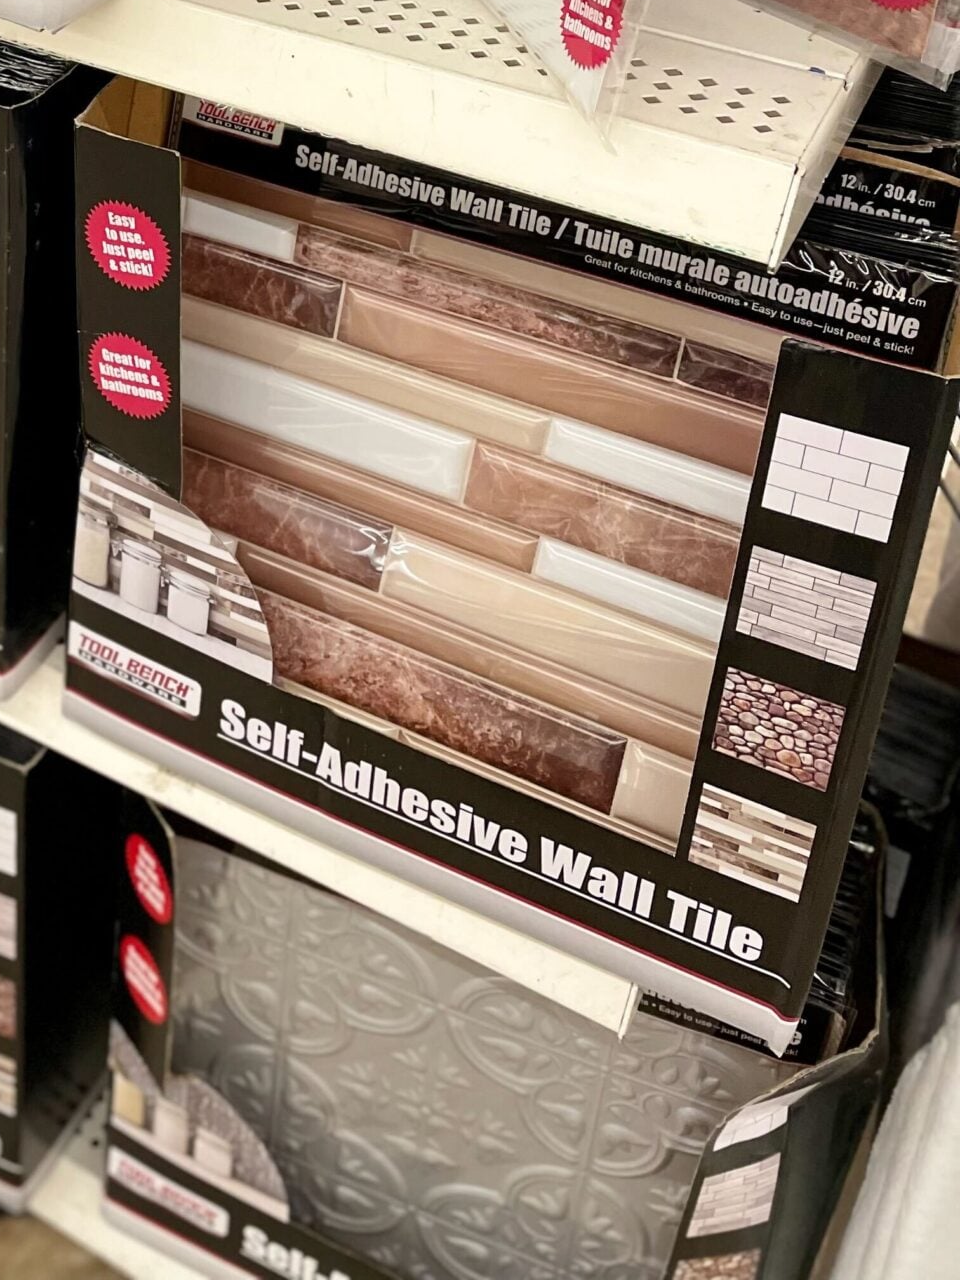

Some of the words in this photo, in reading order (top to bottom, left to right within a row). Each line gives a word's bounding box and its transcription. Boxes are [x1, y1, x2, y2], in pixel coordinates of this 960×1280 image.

[564, 15, 611, 51] bathrooms
[603, 15, 613, 30] &
[198, 114, 269, 138] HARDWARE
[231, 110, 277, 133] BENCH
[841, 173, 857, 190] 12
[858, 182, 871, 194] in.
[873, 183, 884, 195] /
[883, 183, 917, 204] 30.4
[918, 199, 936, 208] cm
[107, 211, 135, 231] Easy
[105, 227, 118, 241] to
[119, 230, 145, 245] use.
[295, 144, 445, 206] Self-Adhesive
[450, 186, 503, 223] Wall
[507, 202, 551, 238] Tile
[554, 218, 570, 240] /
[573, 220, 634, 259] Tuile
[638, 242, 730, 286] murale
[734, 270, 921, 340] autoadhésive
[102, 241, 127, 258] Just
[127, 246, 155, 263] peel
[109, 259, 119, 271] &
[119, 260, 153, 277] stick!
[828, 269, 845, 286] 12
[845, 278, 860, 290] in.
[862, 280, 872, 292] /
[872, 280, 907, 303] 30.4
[907, 297, 927, 308] cm
[584, 254, 612, 270] Great
[613, 262, 628, 274] for
[629, 266, 673, 287] kitchens
[674, 280, 682, 290] &
[685, 282, 741, 307] bathrooms
[751, 302, 778, 319] Easy
[779, 308, 791, 321] to
[846, 330, 871, 345] peel
[873, 337, 881, 348] &
[883, 339, 915, 356] stick!
[101, 348, 133, 367] Great
[134, 354, 151, 370] for
[98, 362, 149, 385] kitchens
[151, 375, 160, 387] &
[101, 377, 164, 402] bathrooms
[79, 632, 124, 670] TOOL
[127, 658, 190, 698] BENCH
[80, 649, 184, 706] HARDWARE
[219, 698, 529, 862] Self-Adhesive
[540, 836, 656, 919] Wall
[666, 890, 764, 962] Tile
[658, 1004, 682, 1019] Easy
[683, 1010, 693, 1022] to
[740, 1032, 762, 1045] peel
